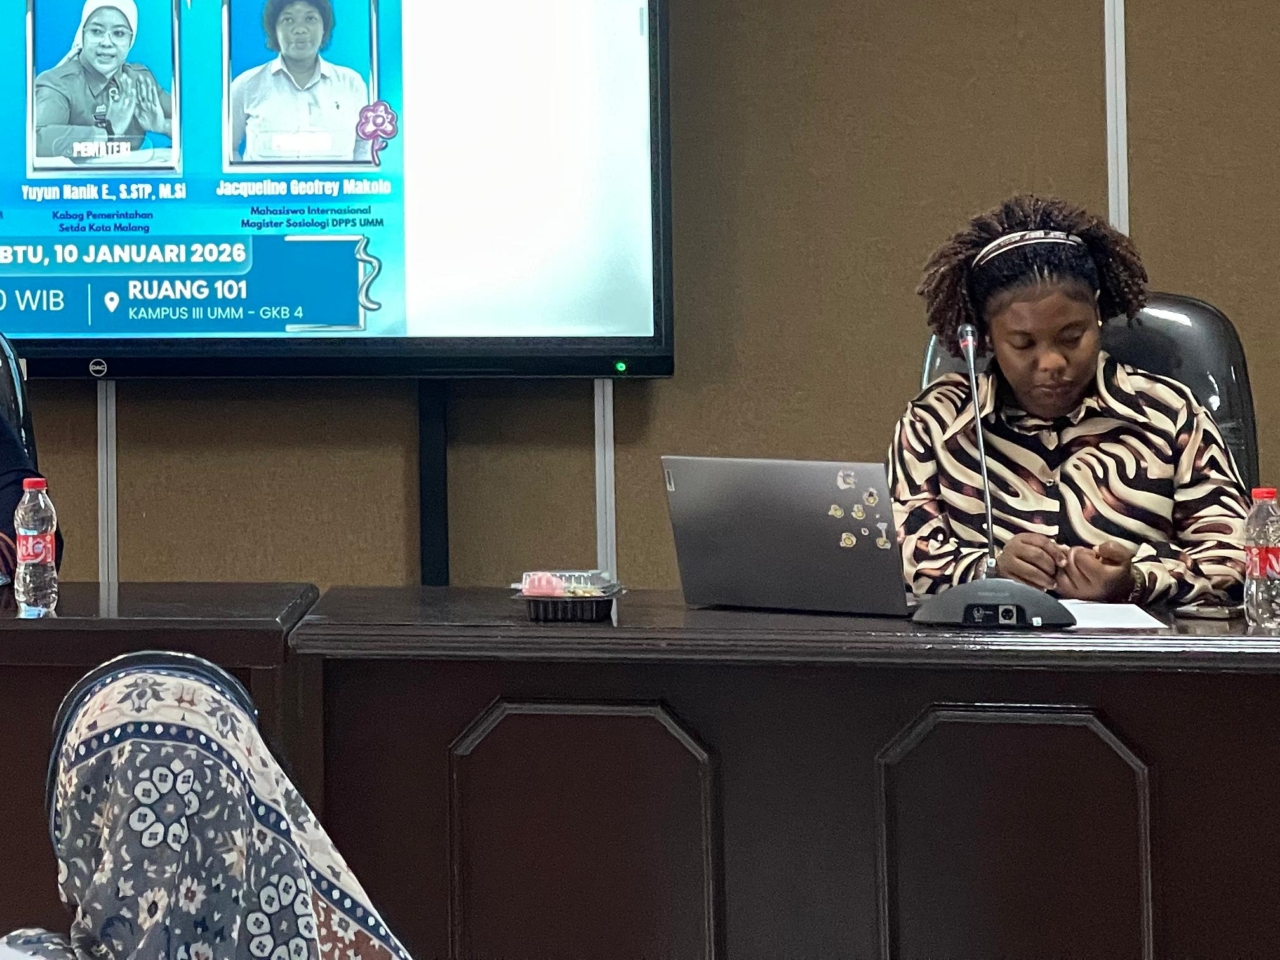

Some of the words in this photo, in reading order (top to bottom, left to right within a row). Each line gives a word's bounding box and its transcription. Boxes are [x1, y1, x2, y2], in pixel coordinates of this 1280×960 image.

[21, 184, 61, 203] Yuyun
[62, 182, 100, 200] Nanik
[101, 183, 117, 201] E.,
[118, 182, 156, 200] S.STP,
[158, 181, 187, 200] M.Si
[216, 179, 288, 198] Jacqueline
[289, 177, 340, 197] Geofrey
[52, 210, 85, 223] Kabag
[86, 209, 154, 220] Pemerintahan
[250, 206, 306, 216] Mahasiswa
[307, 205, 372, 215] Internasional
[58, 223, 87, 233] Setda
[88, 223, 112, 233] Kota
[113, 222, 150, 234] Malang
[240, 218, 284, 231] Magister
[285, 218, 330, 230] Sosiologi
[331, 218, 358, 228] DPPS
[359, 217, 384, 228] UMM
[54, 245, 79, 264] 10
[82, 244, 186, 264] JANUARI
[190, 243, 247, 263] 2026
[128, 279, 210, 300] RUANG
[214, 280, 248, 299] 101
[14, 289, 66, 312] WIB
[128, 307, 189, 321] KAMPUS
[192, 307, 204, 320] III
[207, 307, 245, 320] UMM
[259, 306, 291, 320] GKB
[294, 306, 304, 319] 4
